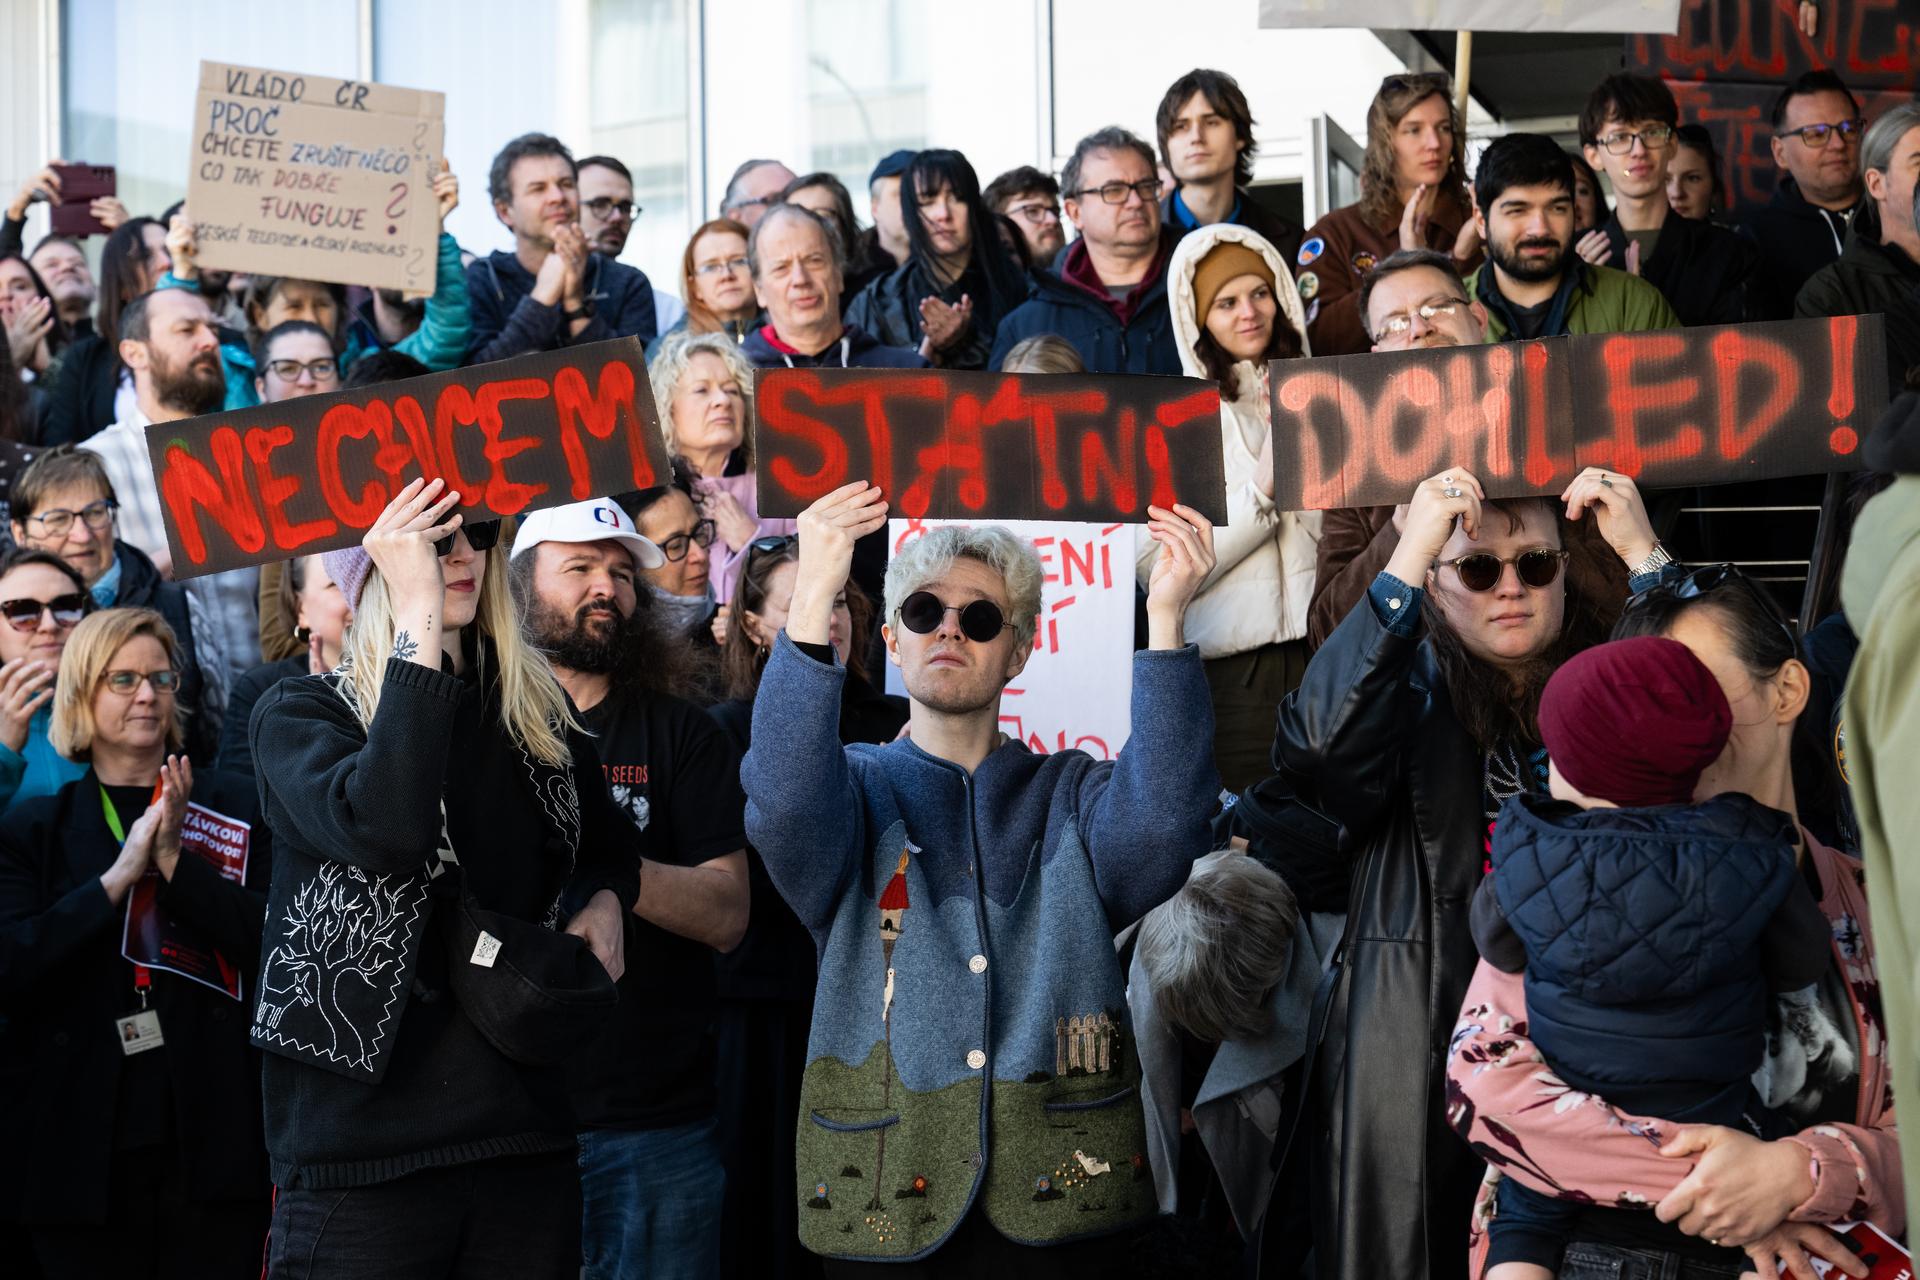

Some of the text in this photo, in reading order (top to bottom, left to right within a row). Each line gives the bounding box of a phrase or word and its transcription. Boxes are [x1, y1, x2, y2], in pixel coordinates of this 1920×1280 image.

[335, 80, 370, 111] ČR
[210, 100, 281, 137] PROČ
[201, 131, 282, 161] CHCETE
[289, 142, 358, 167] ZRUŠIT
[201, 163, 342, 194] CO TAK DOBŘE
[261, 196, 368, 231] FUNGUJE
[758, 369, 1220, 517] STÁTNÍ
[162, 361, 655, 565] NECHCEM
[612, 765, 648, 784] SEEDS
[183, 812, 245, 845] TÁVKOVÁ
